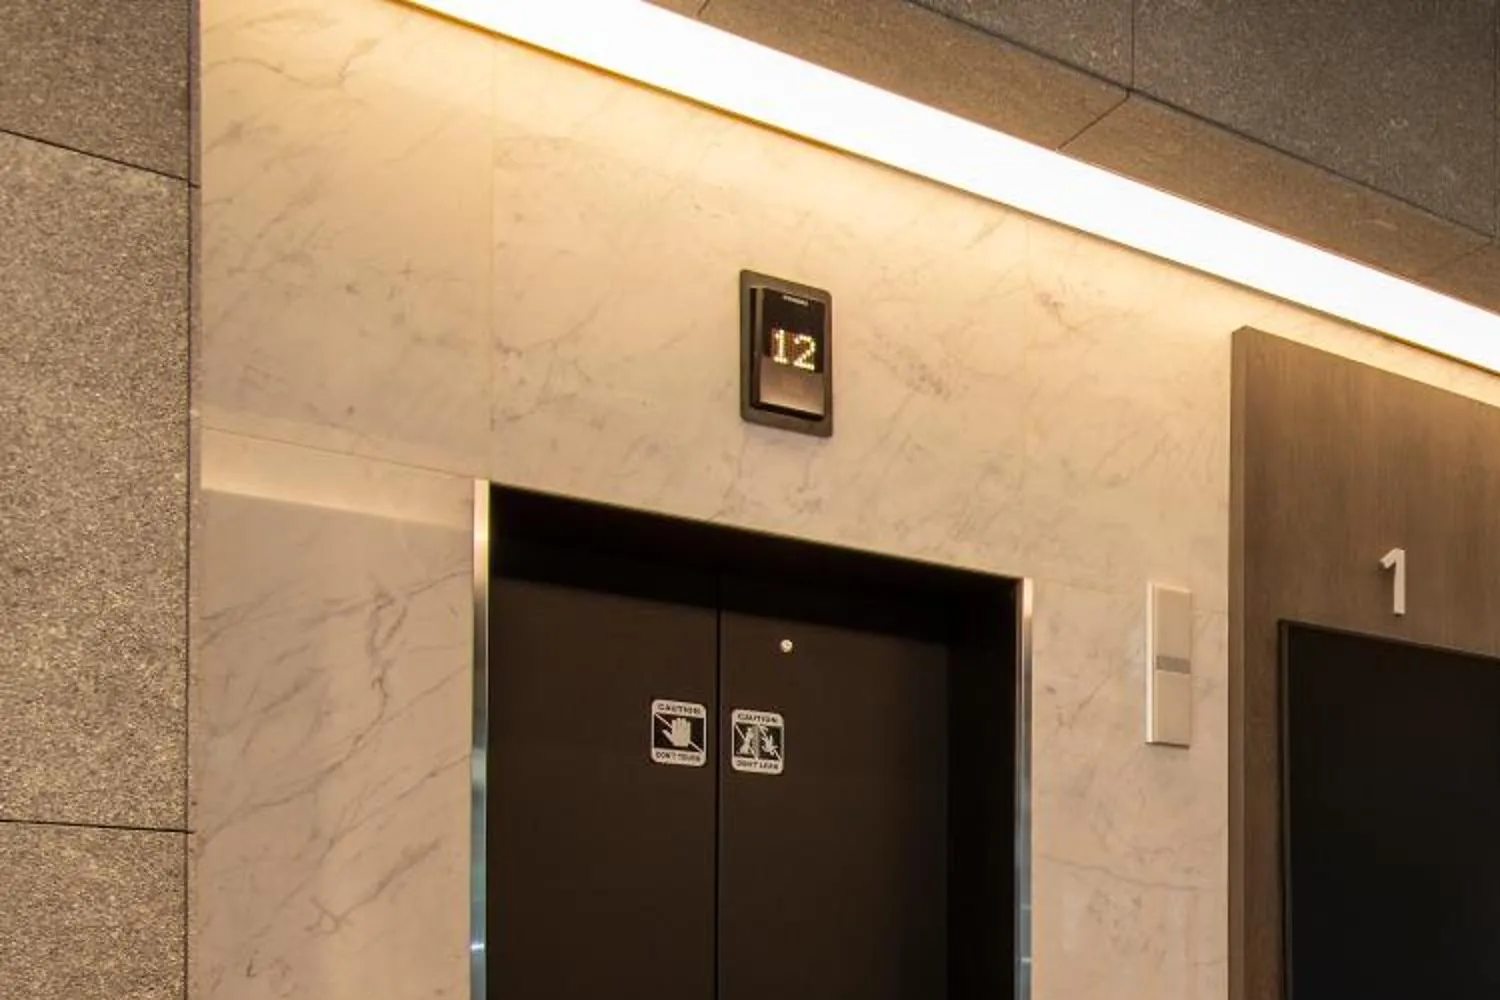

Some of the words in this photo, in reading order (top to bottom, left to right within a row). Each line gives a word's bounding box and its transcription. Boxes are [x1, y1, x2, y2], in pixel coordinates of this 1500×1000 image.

[773, 328, 816, 371] 12
[1379, 547, 1406, 615] 1
[657, 703, 702, 715] CAUTION
[737, 713, 778, 724] CAUTION
